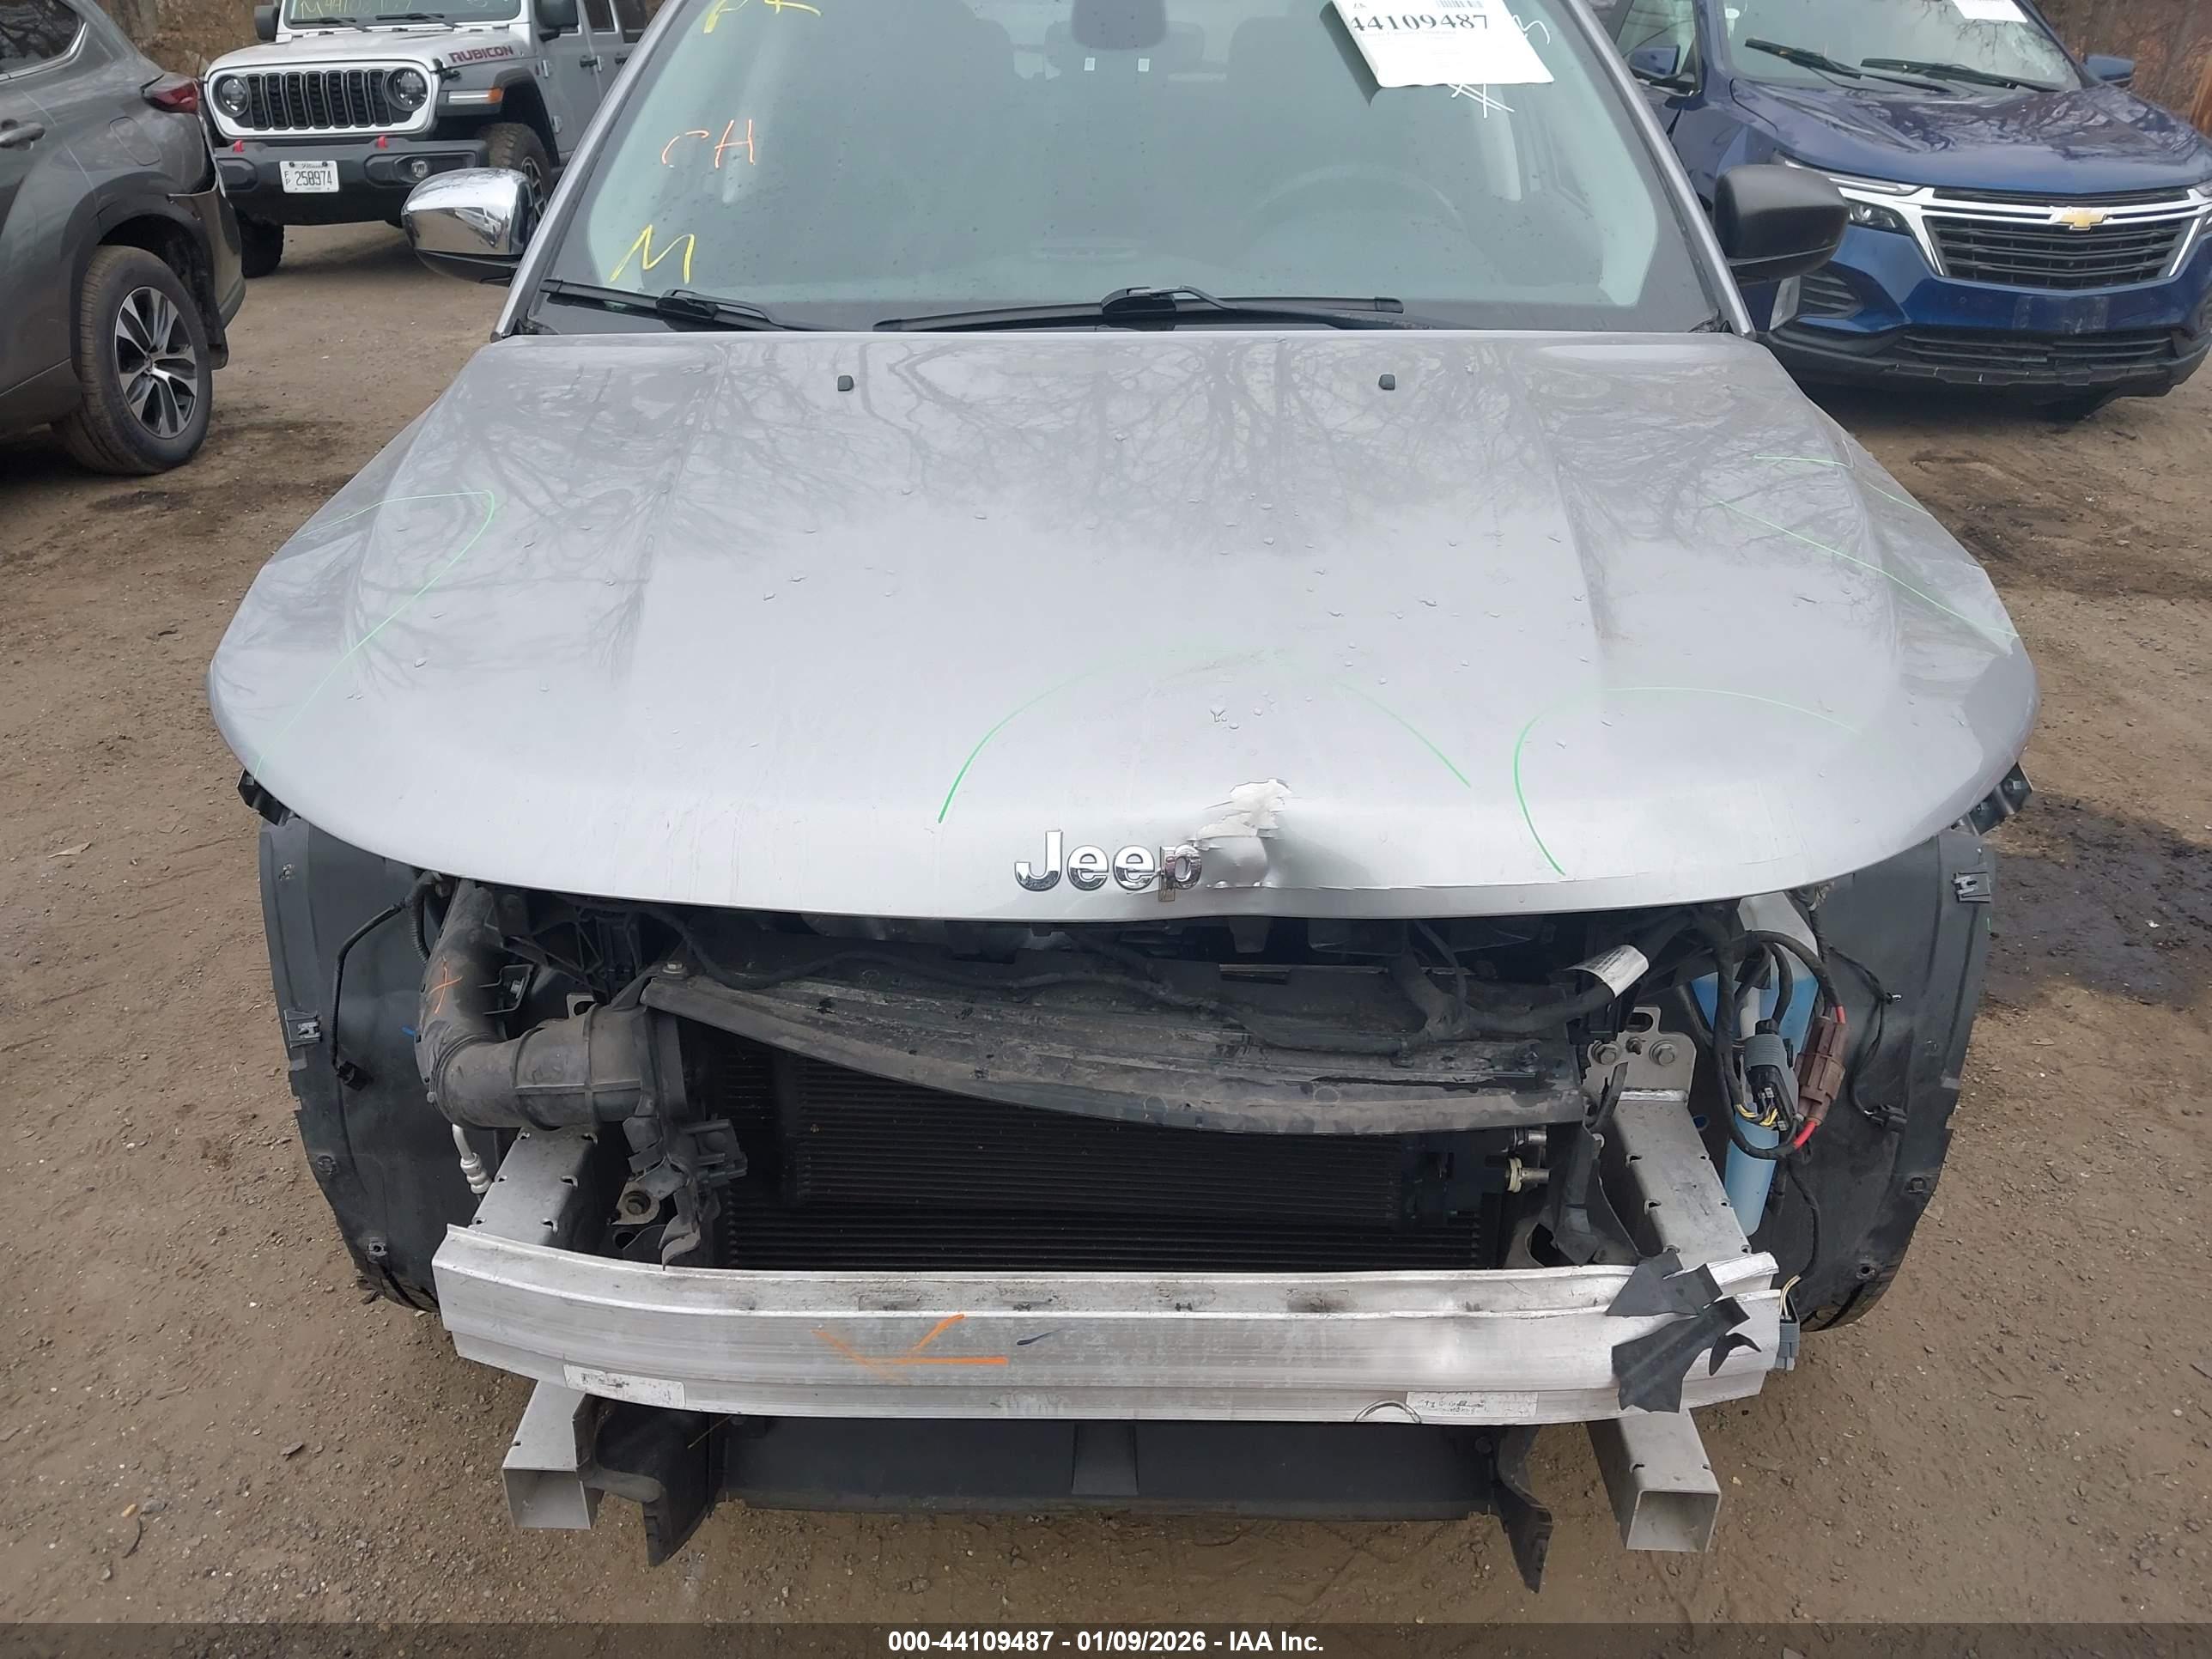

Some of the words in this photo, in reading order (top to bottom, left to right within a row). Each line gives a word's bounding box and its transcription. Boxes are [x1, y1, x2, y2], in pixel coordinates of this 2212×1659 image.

[1351, 14, 1487, 31] 44109487
[447, 45, 514, 63] RUBICON
[295, 170, 332, 186] 258974
[610, 224, 695, 284] M
[1014, 830, 1202, 902] Jeep
